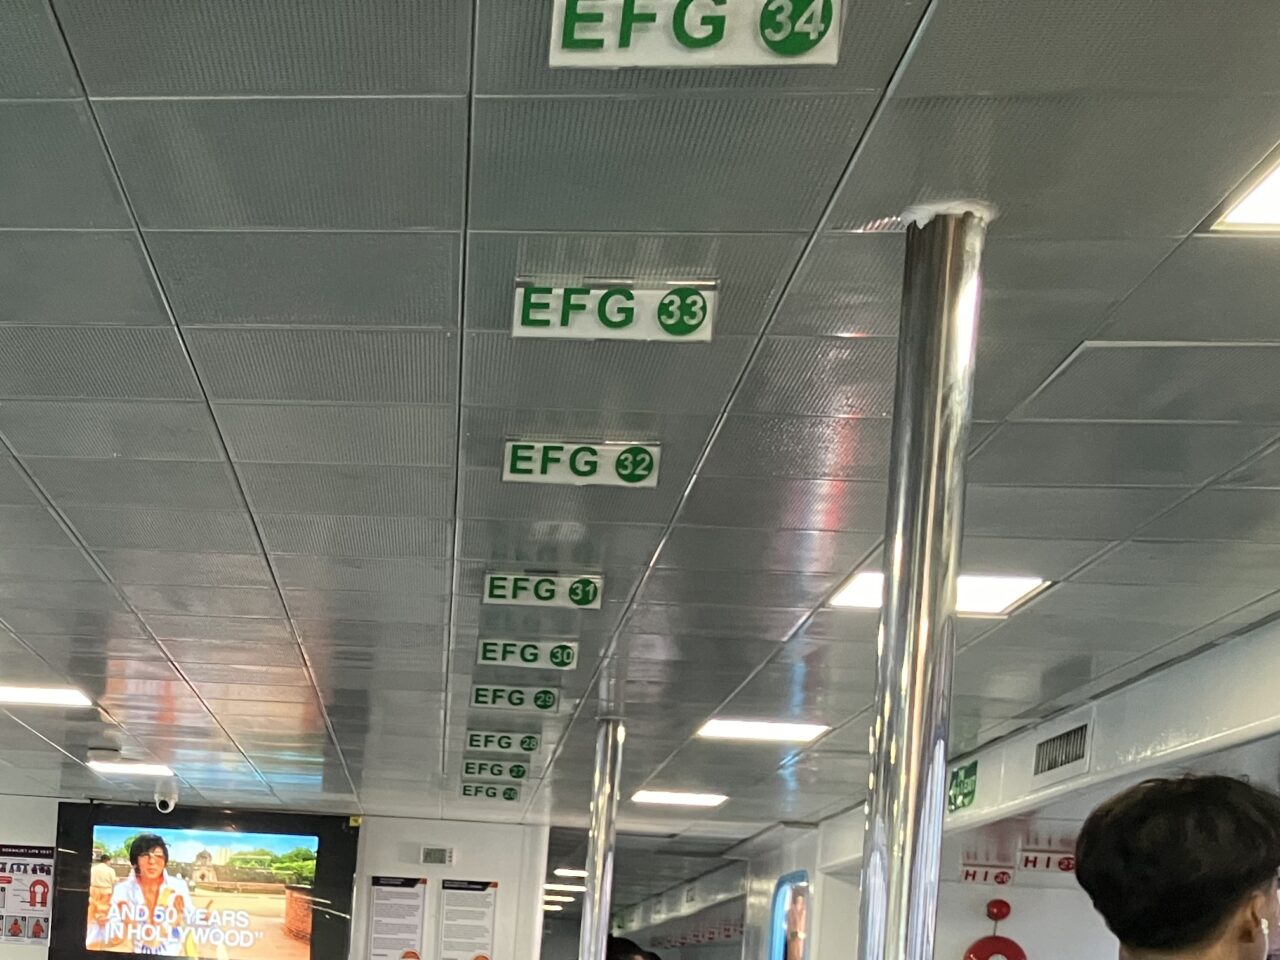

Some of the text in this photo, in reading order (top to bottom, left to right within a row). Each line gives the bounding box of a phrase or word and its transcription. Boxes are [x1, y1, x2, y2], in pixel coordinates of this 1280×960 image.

[763, 0, 826, 42] 34
[520, 287, 706, 328] EFG 33
[509, 444, 652, 477] EFG 32
[488, 576, 596, 601] EFG 31
[481, 642, 574, 664] EFG 30
[474, 687, 555, 706] EFG 29
[468, 734, 538, 750] EFG 28
[464, 762, 504, 776] EFG
[462, 785, 497, 798] EFG
[107, 903, 249, 928] AND 50 YEARS
[105, 922, 124, 944] IN
